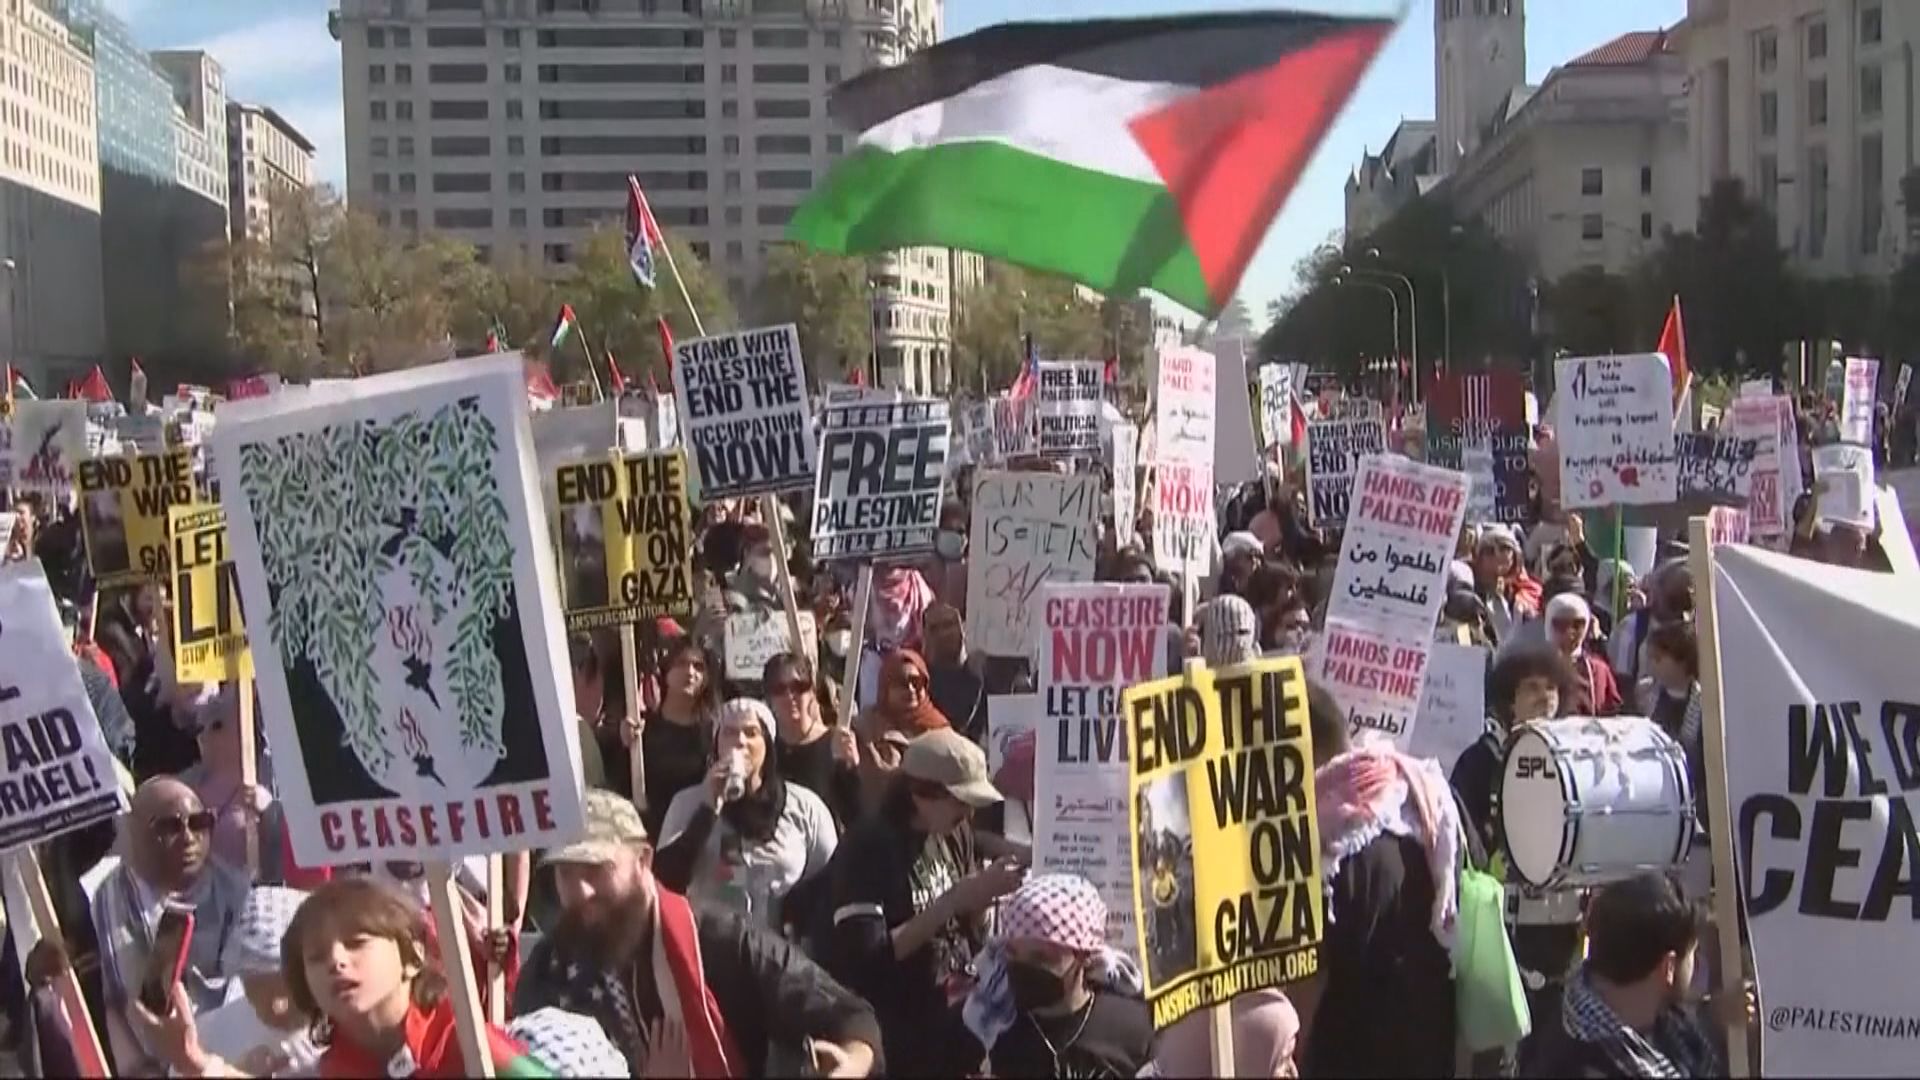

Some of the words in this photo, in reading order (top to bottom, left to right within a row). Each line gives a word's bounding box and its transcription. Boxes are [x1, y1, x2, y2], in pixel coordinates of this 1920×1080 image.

[679, 336, 739, 365] STAND
[743, 329, 790, 353] WITH
[683, 349, 796, 386] PALESTINE!
[687, 383, 742, 419] END
[748, 375, 799, 408] THE
[1041, 369, 1074, 387] FREE
[1077, 367, 1098, 386] ALL
[692, 410, 803, 446] OCCUPATION
[1041, 415, 1098, 431] POLITICAL
[1309, 423, 1348, 439] STAND
[80, 459, 131, 491] END
[137, 452, 190, 487] THE
[557, 462, 617, 505] END
[624, 454, 681, 497] THE
[697, 432, 808, 488] NOW!
[820, 424, 947, 499] FREE
[1311, 452, 1347, 474] END
[1160, 480, 1207, 518] NOW
[1313, 490, 1350, 518] NO
[1365, 470, 1425, 503] HANDS
[1431, 485, 1464, 512] OFF
[616, 494, 684, 536] WAR
[1359, 495, 1456, 537] PALESTINE
[140, 544, 171, 577] GA
[175, 525, 228, 571] LET
[648, 526, 686, 567] ON
[1350, 543, 1377, 563] من
[1385, 543, 1445, 574] اطلعوا
[621, 566, 690, 606] GAZA
[1349, 576, 1428, 605] فلسطين
[1046, 595, 1165, 628] CEASEFIRE
[1052, 628, 1157, 684] NOW
[1327, 631, 1389, 667] HANDS
[1393, 648, 1427, 674] OFF
[1322, 657, 1422, 700] PALESTINE
[1047, 685, 1089, 717] LET
[1097, 683, 1125, 717] GA
[1, 706, 83, 773] AID
[1132, 687, 1207, 775] END
[1214, 669, 1302, 750] THE
[1348, 705, 1407, 739] اطلعوا
[1516, 756, 1556, 779] SPL
[1788, 701, 1888, 797] WE
[0, 755, 101, 818] RAEL!
[1206, 744, 1307, 829] WAR
[320, 788, 556, 853] CEASEFIRE
[1250, 815, 1313, 886] ON
[1215, 882, 1316, 964] GAZA
[1153, 948, 1318, 1030] ANSWERCOALITION.ORG
